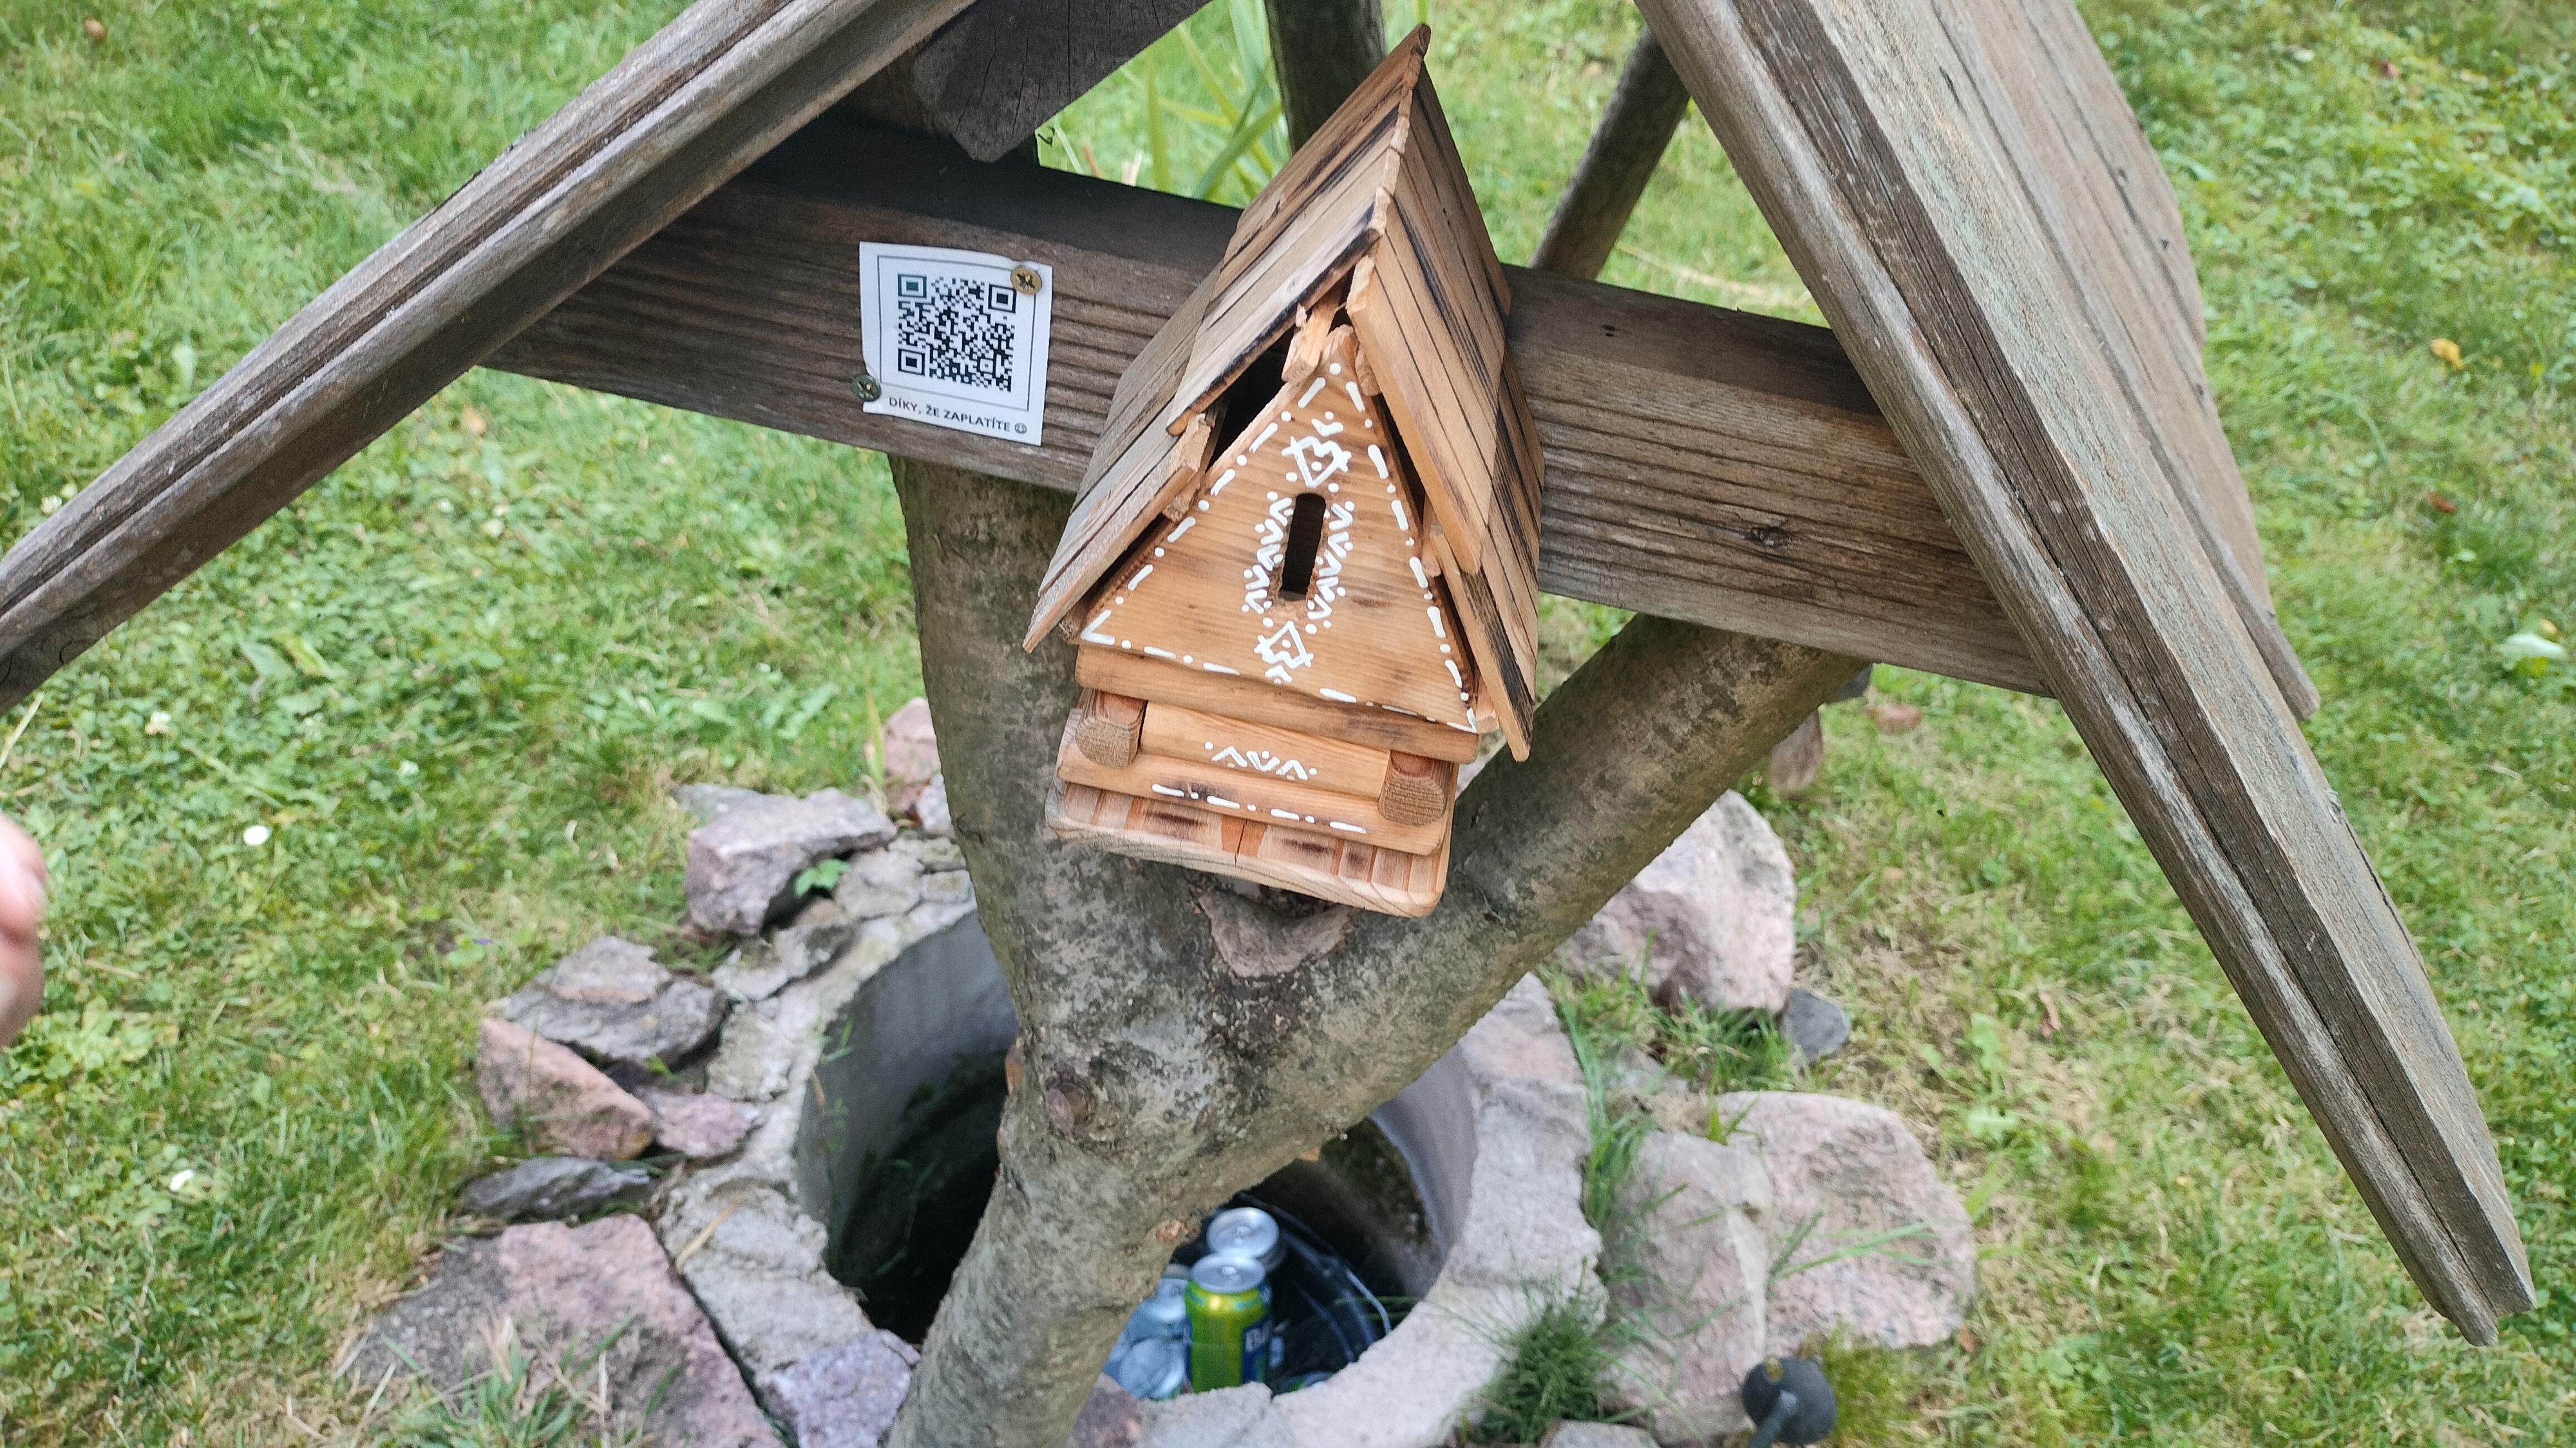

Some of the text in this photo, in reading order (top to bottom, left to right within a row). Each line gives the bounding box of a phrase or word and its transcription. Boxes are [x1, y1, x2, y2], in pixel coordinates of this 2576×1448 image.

[889, 397, 1010, 432] DÍKY, ŽE ZAPLATÍTE
